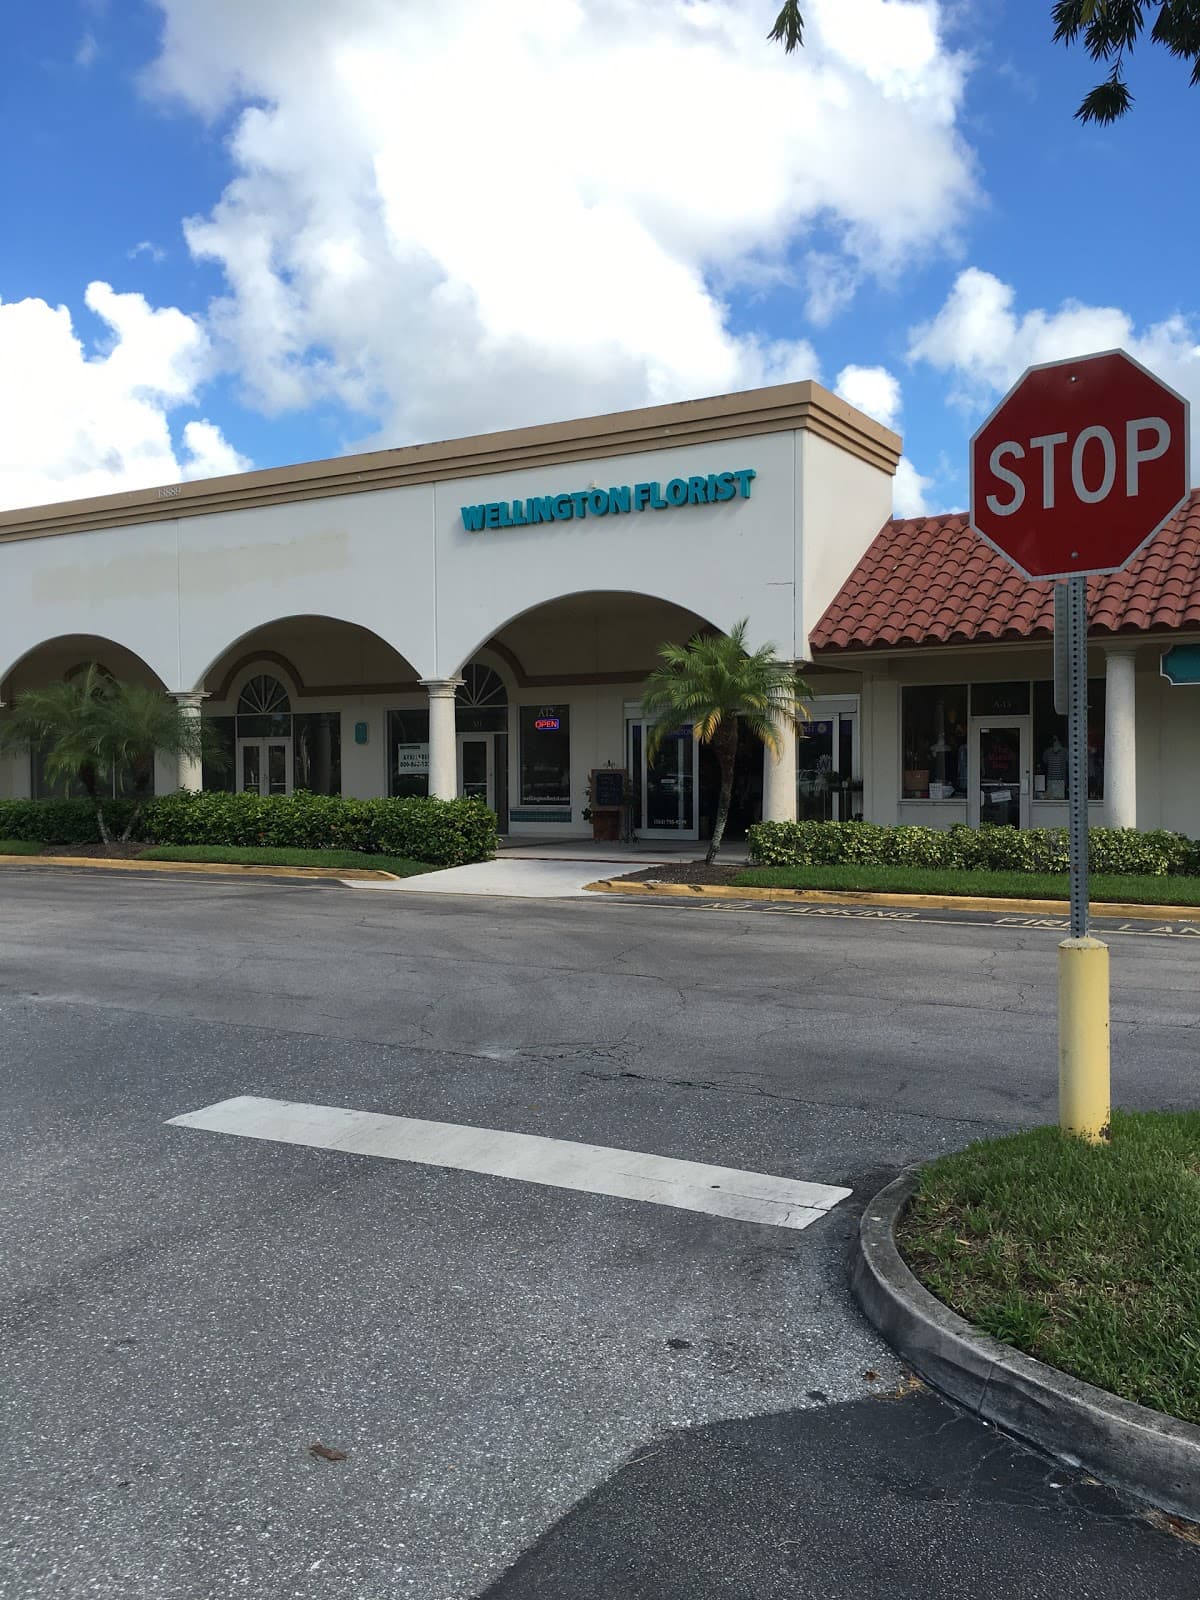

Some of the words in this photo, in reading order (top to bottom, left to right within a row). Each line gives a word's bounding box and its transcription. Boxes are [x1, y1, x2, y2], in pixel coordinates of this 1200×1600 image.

[986, 416, 1172, 517] STOP
[461, 485, 631, 532] WELLINGTON
[635, 469, 757, 511] FLORIST
[535, 719, 557, 728] OPEN
[764, 906, 920, 919] PARKING
